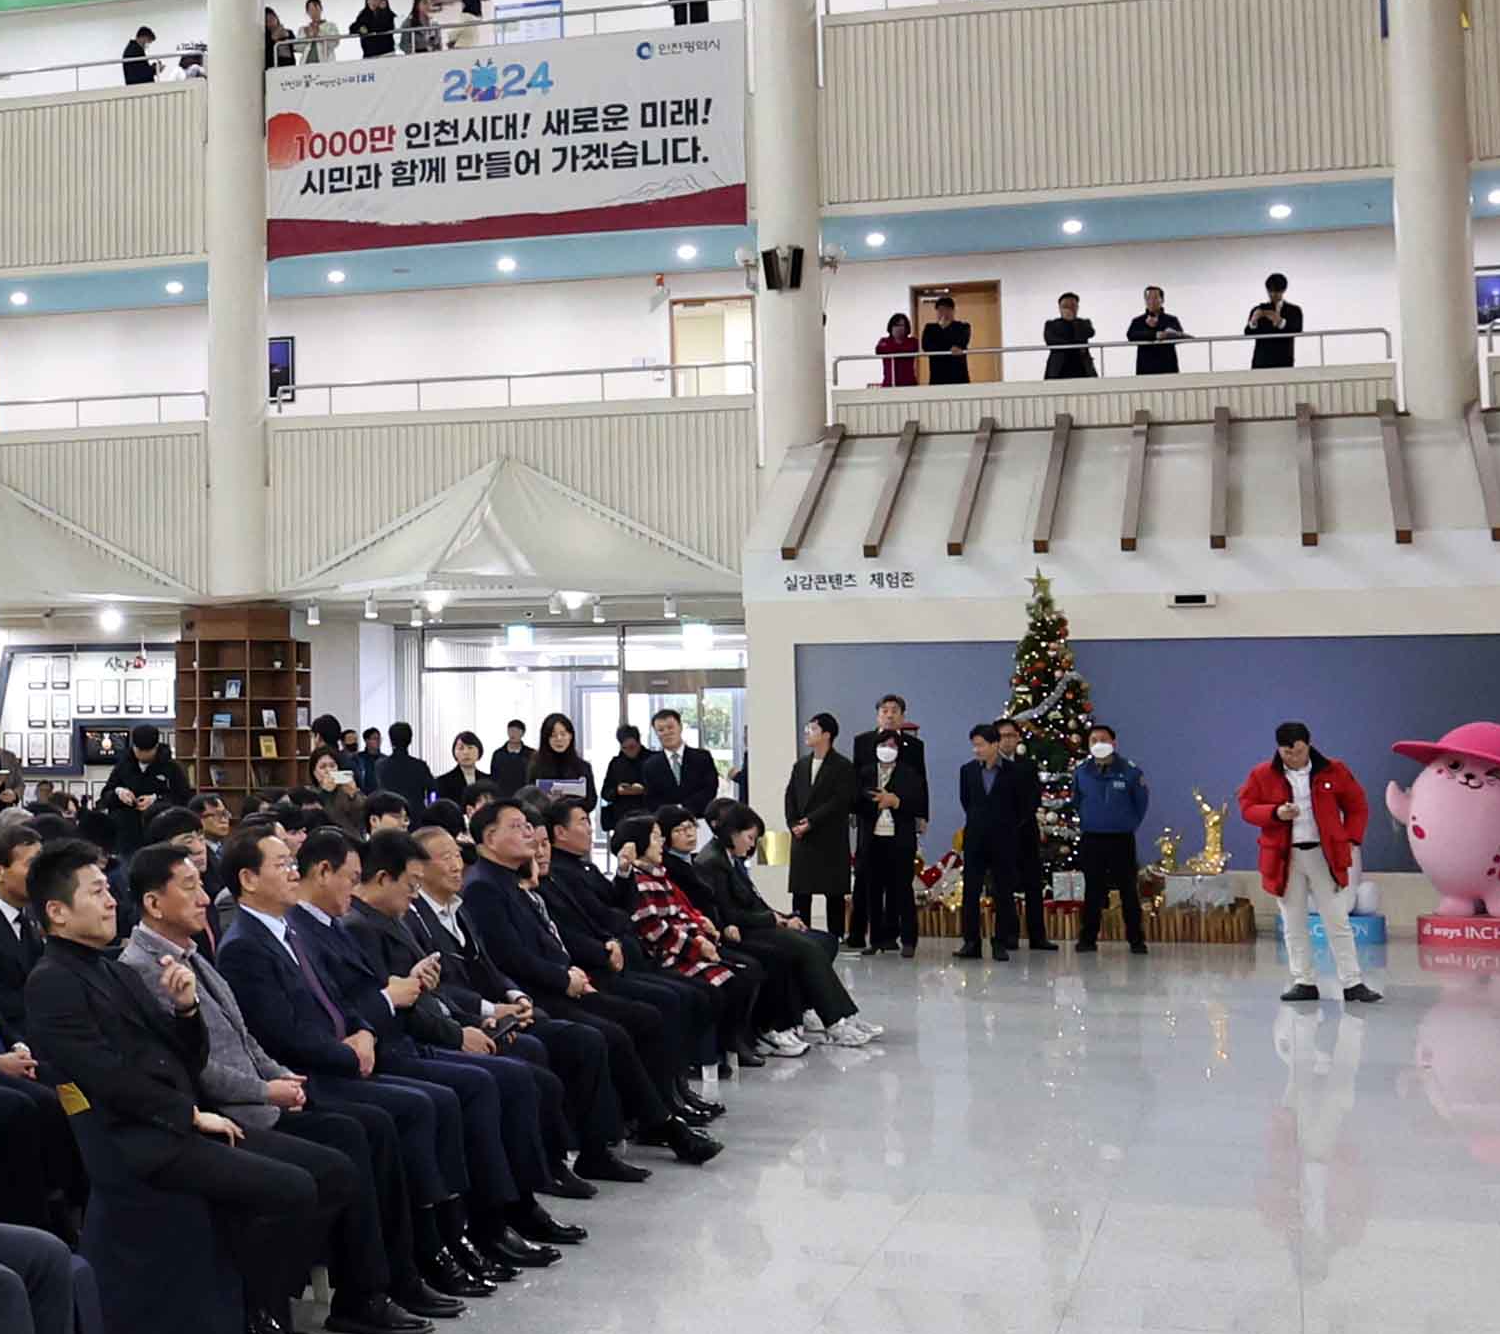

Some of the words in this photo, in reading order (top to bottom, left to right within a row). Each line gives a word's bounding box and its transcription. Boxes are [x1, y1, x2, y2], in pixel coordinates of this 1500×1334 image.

[658, 39, 721, 56] 인천광역시
[295, 124, 396, 161] 1000만
[404, 112, 531, 150] 인천시대!
[542, 103, 629, 137] 새로운
[640, 97, 713, 129] 미래!
[300, 163, 383, 196] 시민과
[391, 157, 447, 187] 함께
[456, 147, 541, 182] 만들어
[551, 136, 710, 174] 가겠습니다.
[783, 572, 857, 592] 실감콘텐츠
[869, 571, 914, 589] 체험존
